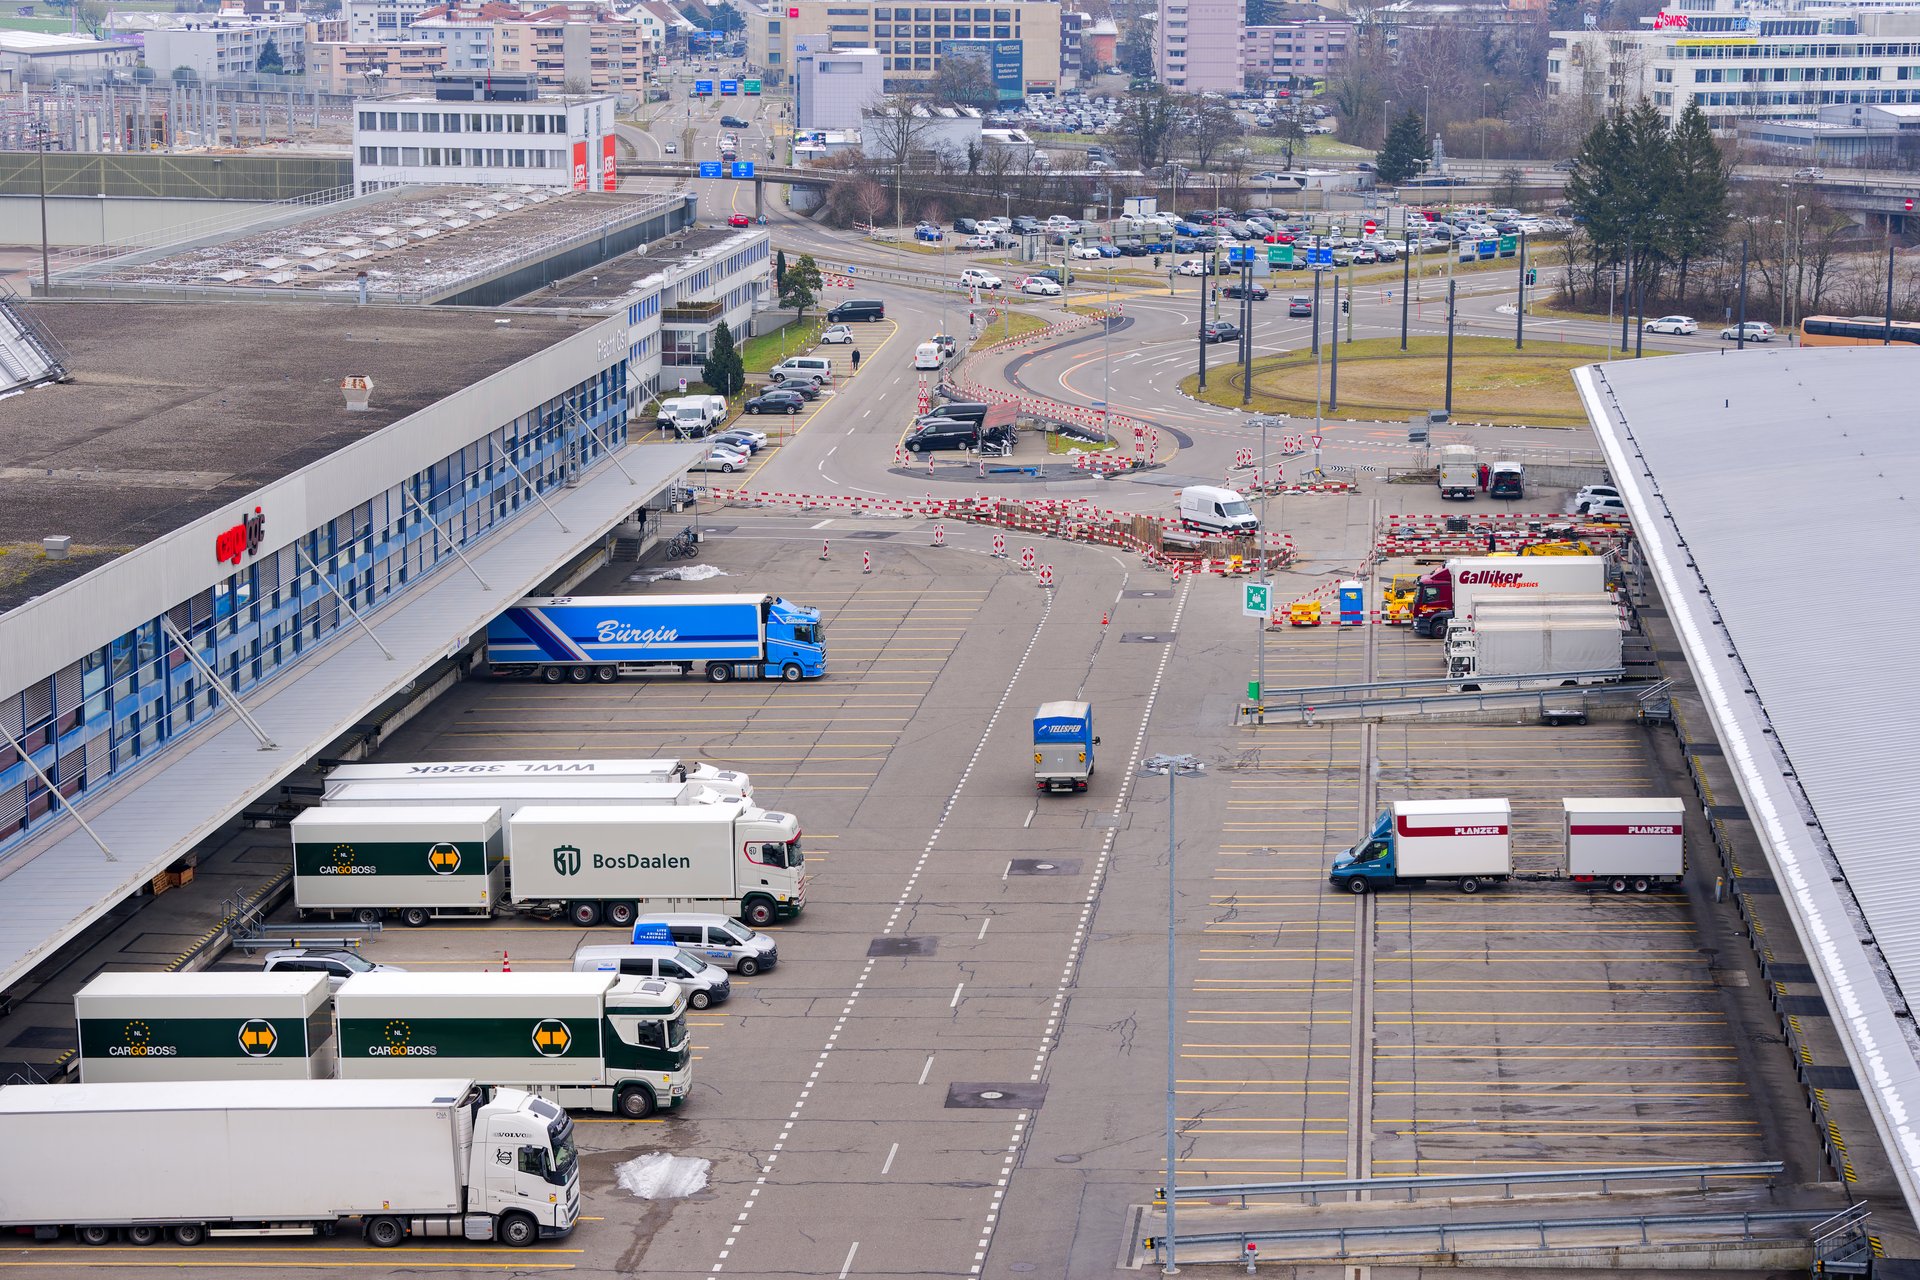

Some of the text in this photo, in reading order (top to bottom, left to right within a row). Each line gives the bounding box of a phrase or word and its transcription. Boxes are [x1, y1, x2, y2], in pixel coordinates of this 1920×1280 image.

[1665, 14, 1688, 27] SWISS
[1459, 570, 1523, 585] Galliker
[596, 620, 678, 648] Bürgin
[1049, 725, 1081, 733] TELESPED
[406, 763, 595, 774] WWL 3926K
[1455, 827, 1499, 835] PLANZER
[1628, 826, 1674, 834] PLANZER
[593, 853, 690, 869] BosDaalen
[319, 866, 377, 874] CARGOBOSS
[109, 1046, 177, 1056] CARGOBOSS
[368, 1046, 437, 1056] CARGOBOSS
